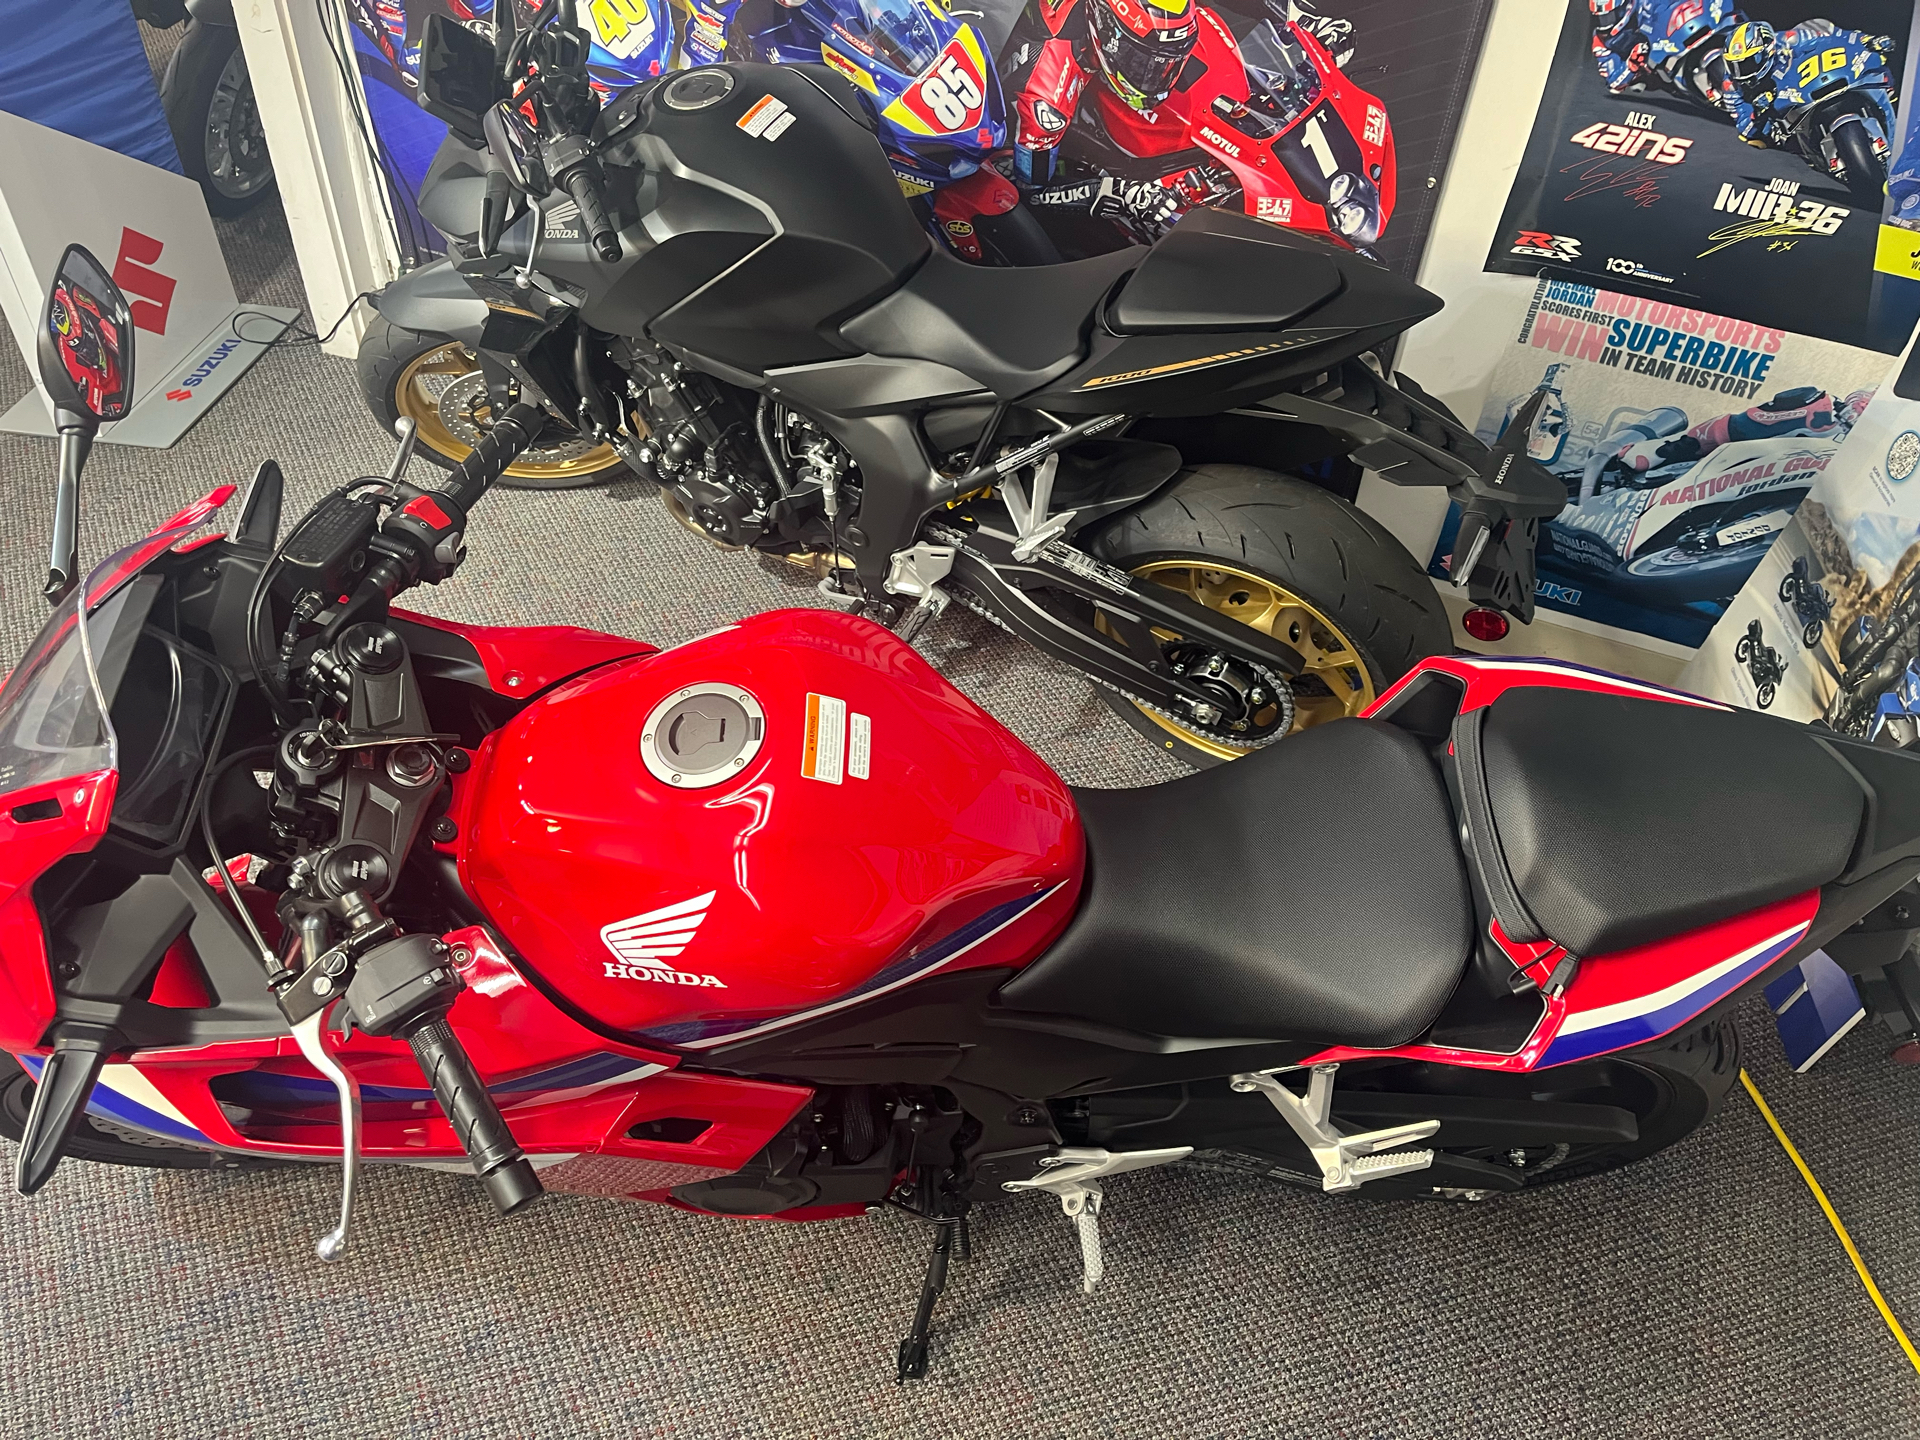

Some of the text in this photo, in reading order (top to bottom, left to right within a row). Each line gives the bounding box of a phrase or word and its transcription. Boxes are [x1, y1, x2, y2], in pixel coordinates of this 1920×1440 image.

[1054, 57, 1070, 103] IXON
[1797, 47, 1847, 88] 36
[920, 54, 982, 130] 85
[1624, 111, 1656, 130] ALEX
[1200, 126, 1241, 158] MOTUL
[1030, 185, 1091, 206] SUZUKI
[1764, 177, 1800, 197] JOAN
[1258, 198, 1291, 216] ヨシムラ
[949, 221, 972, 234] sbs
[1510, 246, 1580, 262] GSX
[1633, 270, 1675, 284] ANNIVERSARY
[1545, 286, 1596, 308] JORDAN
[1540, 300, 1614, 327] SCORES FIRST
[1592, 290, 1785, 353] MOTORSPORTS
[1531, 312, 1610, 363] WIN
[1607, 318, 1775, 383] SUPERBIKE
[183, 338, 242, 387] SUZUKI
[1599, 346, 1762, 400] IN TEAM HISTORY
[1099, 370, 1152, 384] 1000
[1583, 423, 1600, 434] 54
[1563, 443, 1589, 460] 54
[1495, 453, 1515, 485] HONDA
[1660, 459, 1775, 506] NATIONAL
[1736, 471, 1818, 497] jordan
[602, 962, 728, 988] HONDA
